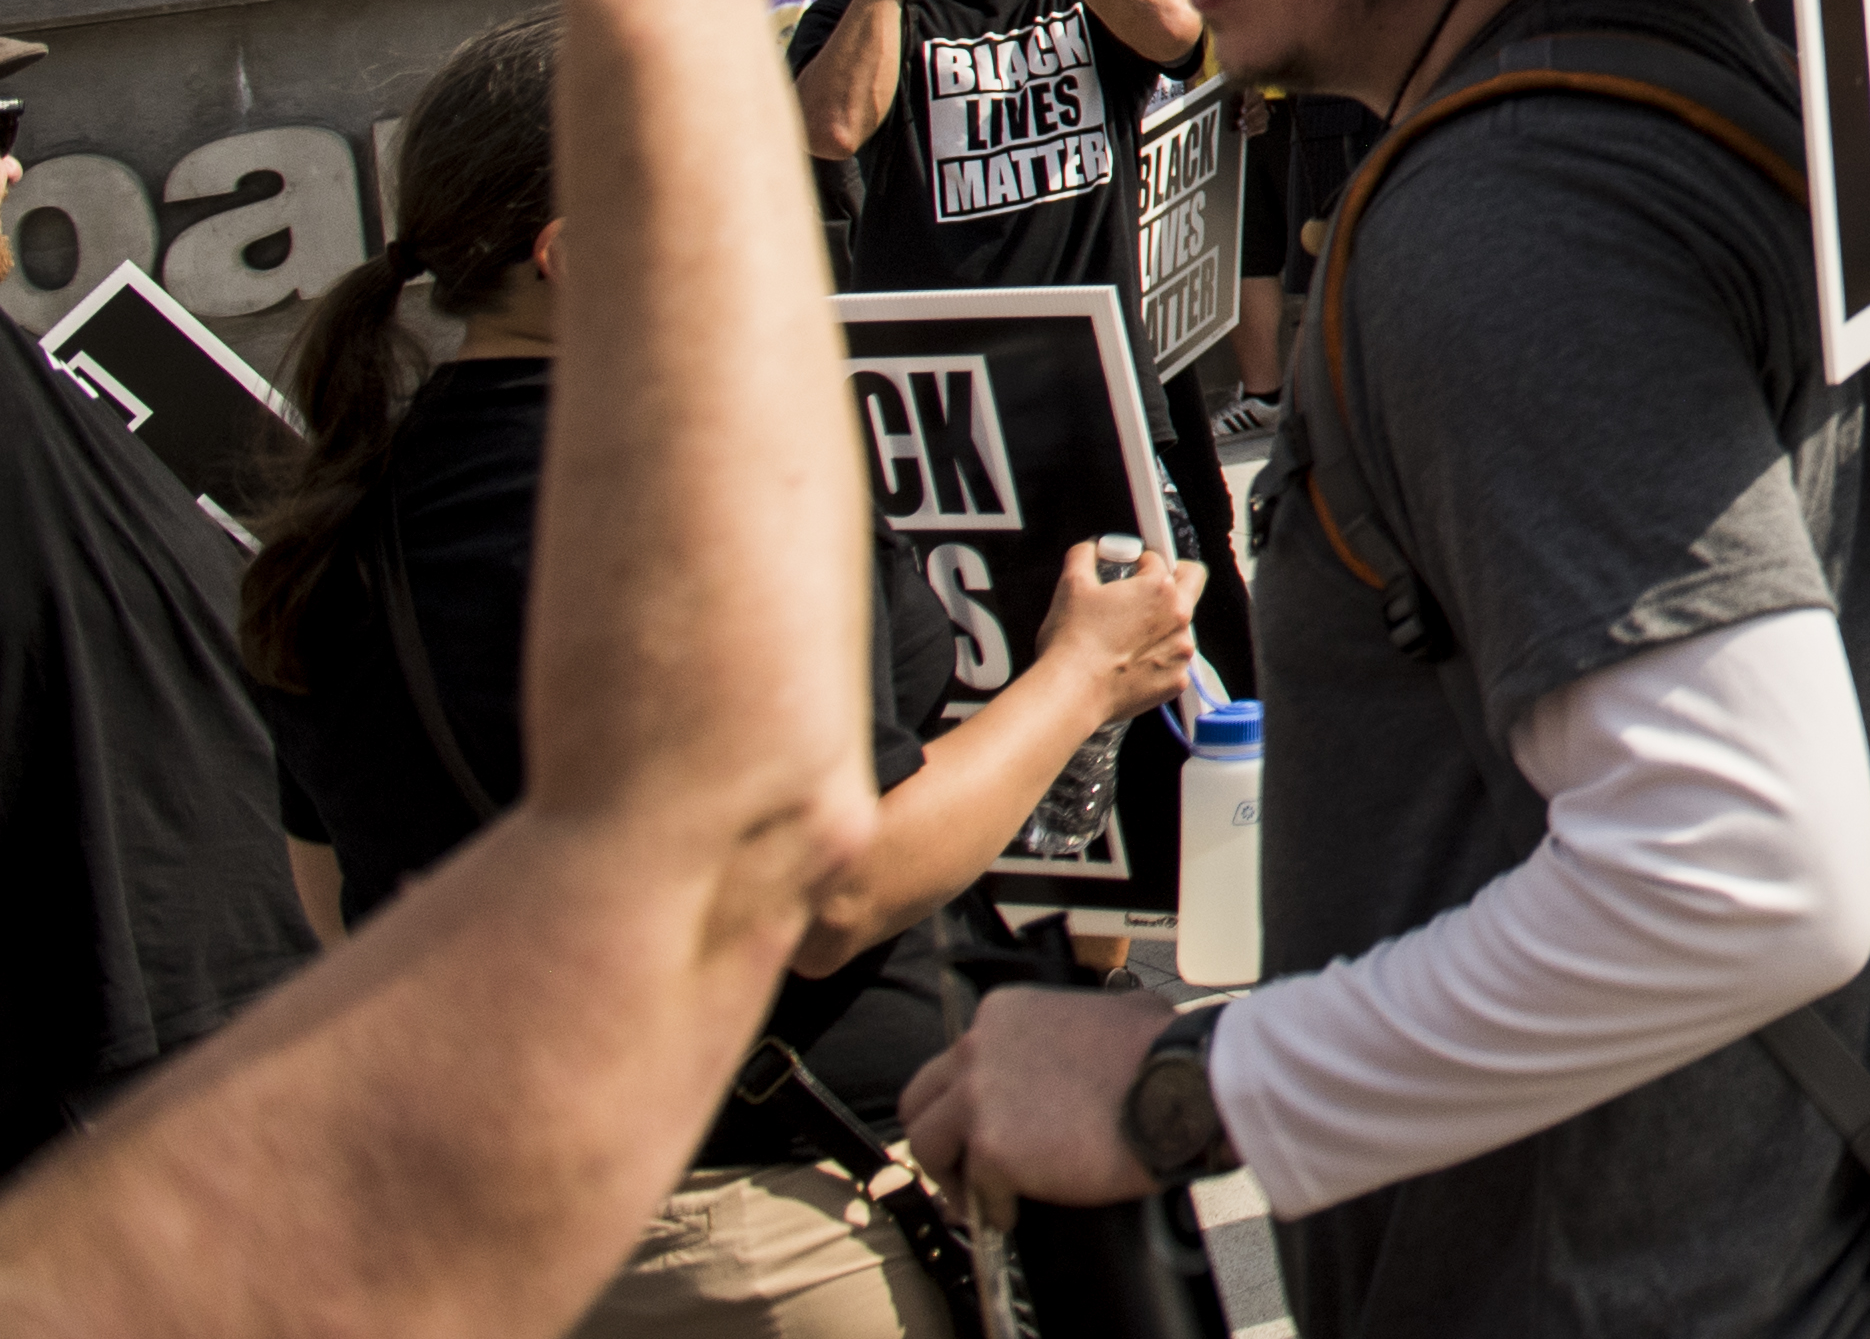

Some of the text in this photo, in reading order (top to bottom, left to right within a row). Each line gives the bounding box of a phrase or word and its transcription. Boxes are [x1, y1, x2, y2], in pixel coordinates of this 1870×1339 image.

[935, 17, 1088, 97] BLACK
[967, 75, 1082, 152] LIVES
[941, 130, 1110, 213] MATTER
[1140, 111, 1217, 214] BLACK
[1140, 191, 1206, 293] LIVES
